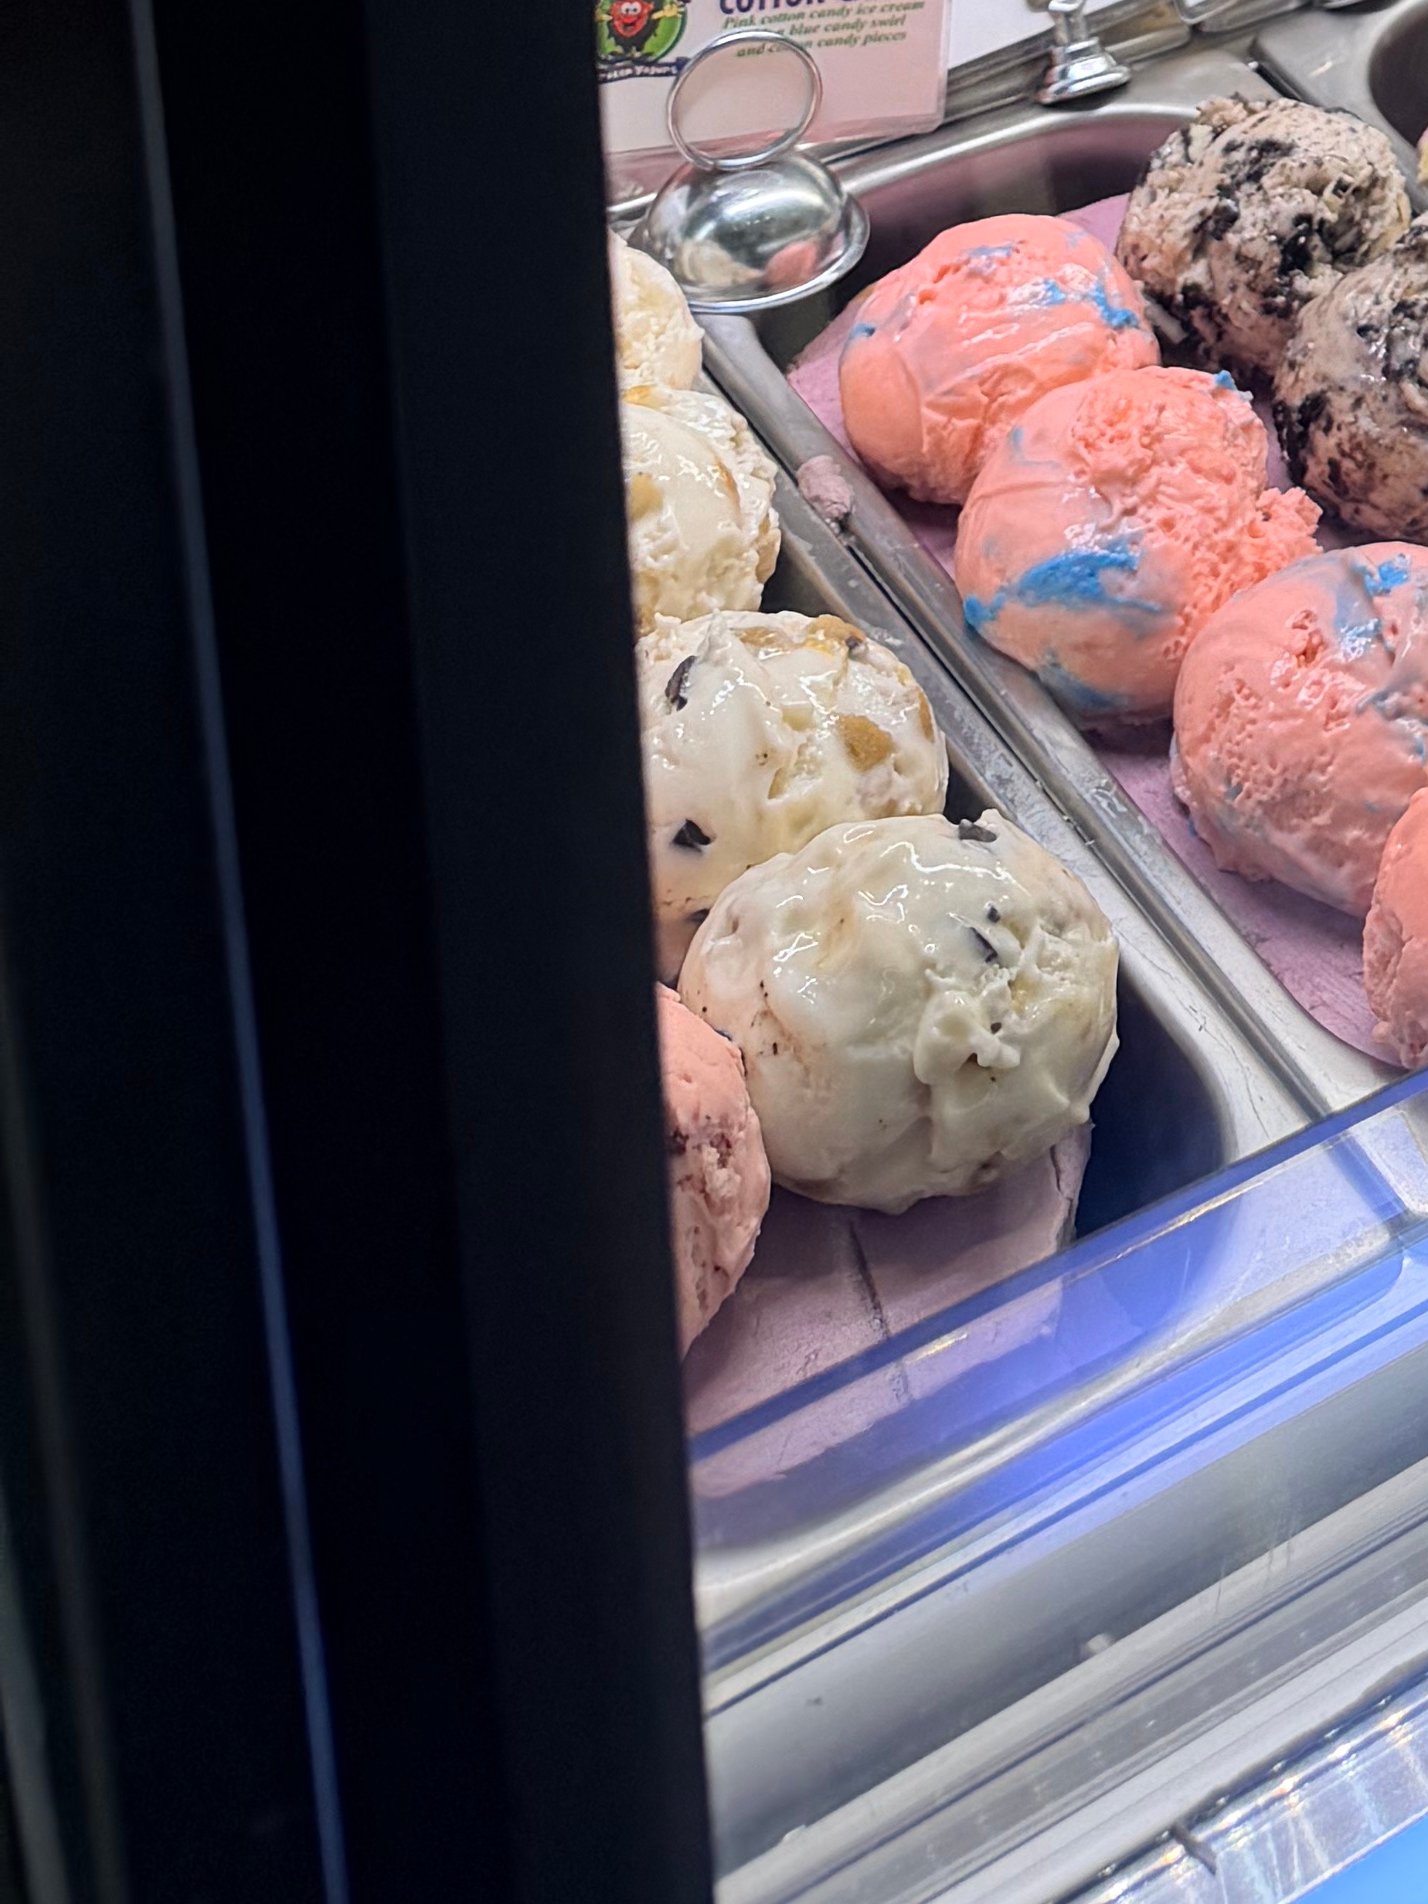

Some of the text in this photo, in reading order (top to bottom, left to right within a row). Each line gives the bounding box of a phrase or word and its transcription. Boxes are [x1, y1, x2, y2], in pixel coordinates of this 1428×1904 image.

[722, 16, 757, 30] Pink
[810, 6, 851, 23] candy
[856, 3, 875, 15] ice
